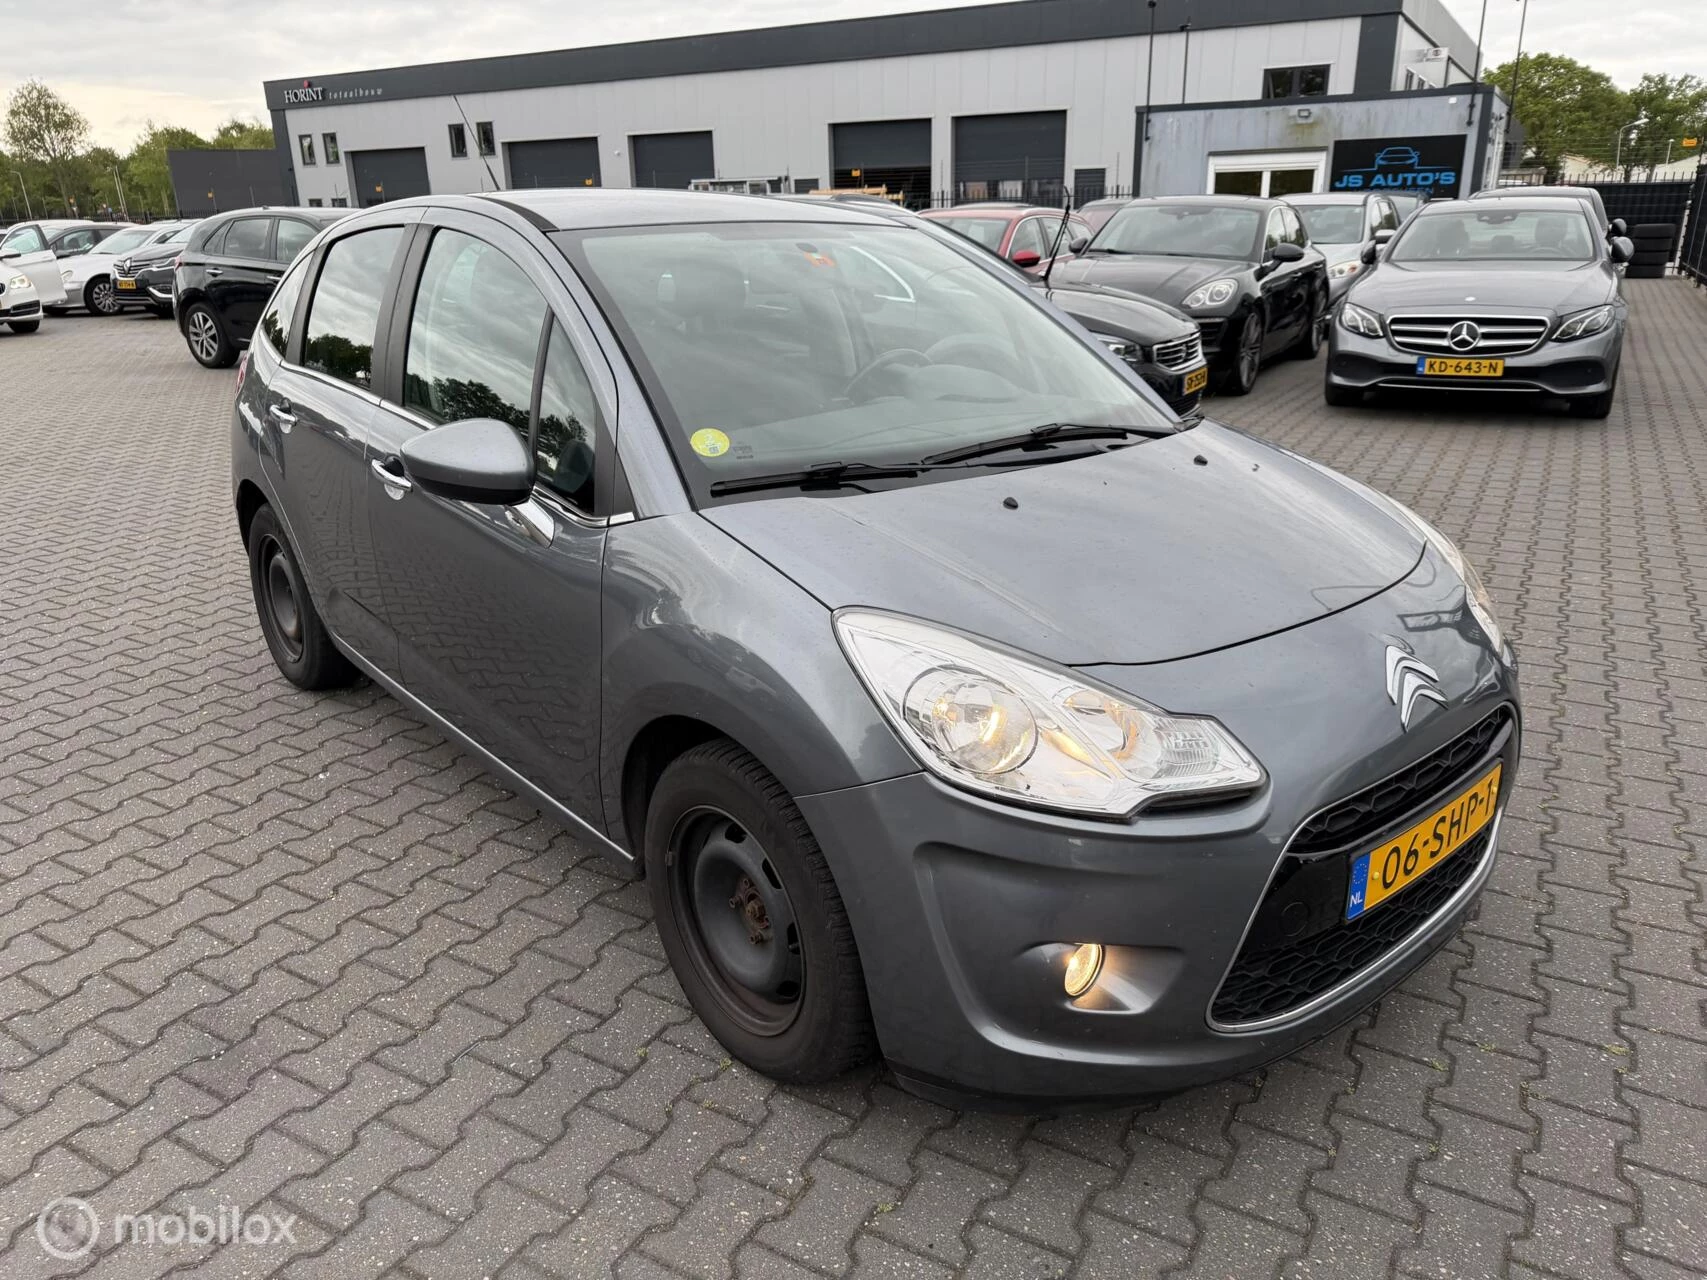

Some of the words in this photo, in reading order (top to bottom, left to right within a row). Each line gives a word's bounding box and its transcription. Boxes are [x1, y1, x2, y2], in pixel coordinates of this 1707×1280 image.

[284, 86, 323, 104] HORINT
[1334, 174, 1363, 188] JS
[1369, 171, 1456, 187] AUTO'S
[1428, 360, 1499, 374] KD-643-N
[1350, 890, 1363, 908] NL
